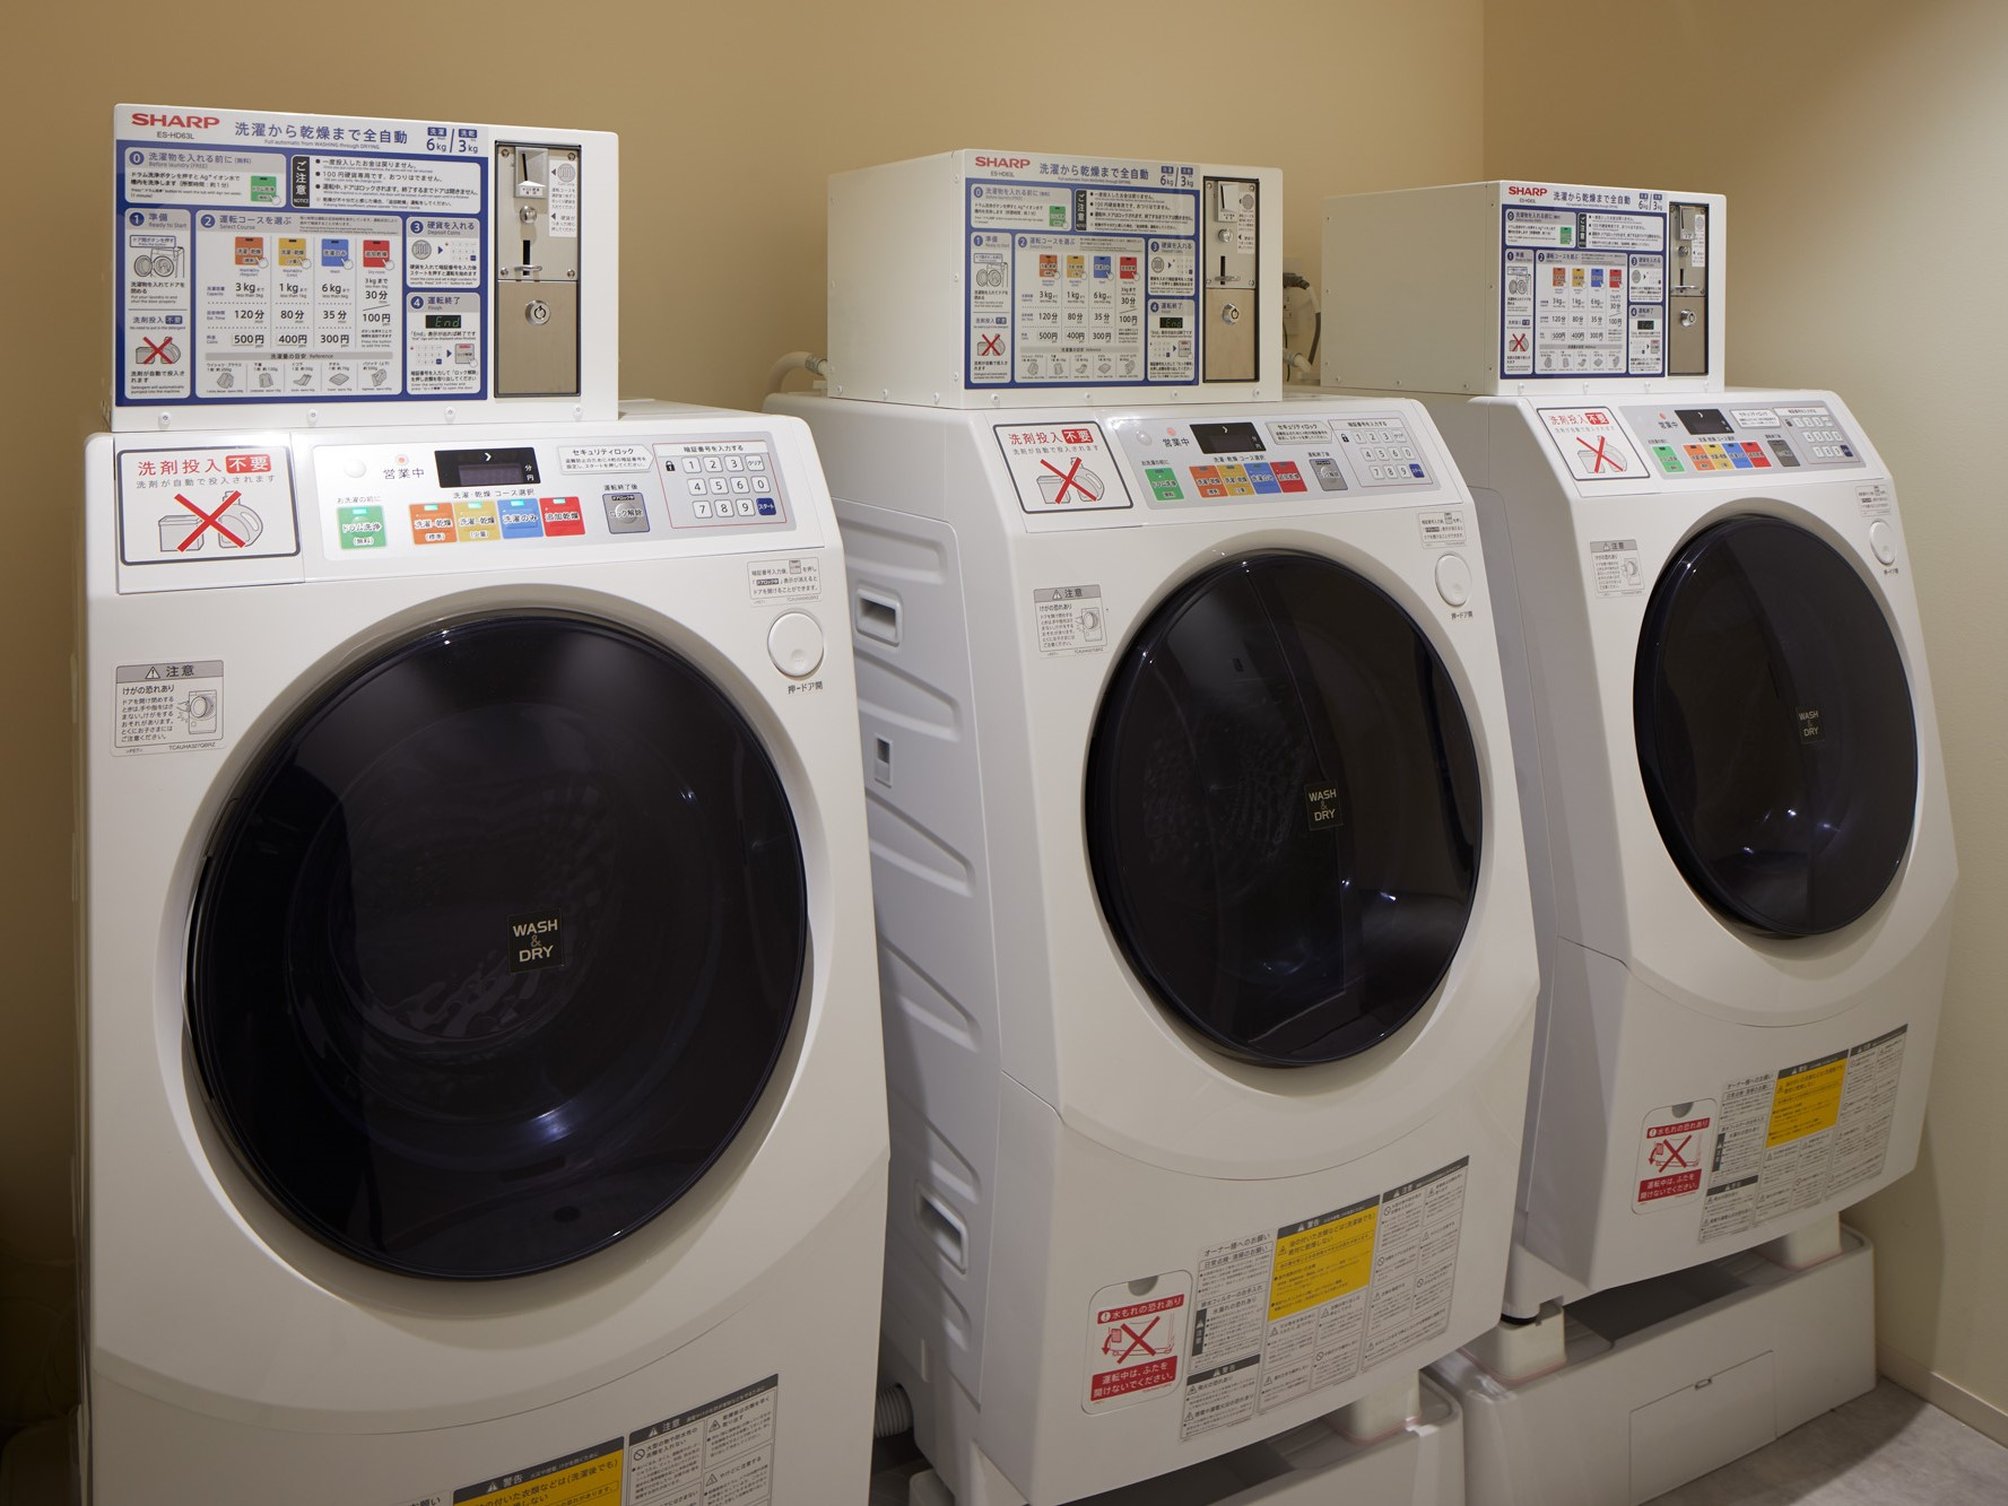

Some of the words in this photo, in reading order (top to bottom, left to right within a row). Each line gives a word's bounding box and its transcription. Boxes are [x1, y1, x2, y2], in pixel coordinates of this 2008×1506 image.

[132, 113, 220, 129] SHARP
[234, 122, 408, 144] 洗濯から乾燥まで全自動
[149, 153, 232, 164] 洗濯物を入れる前に
[975, 156, 1030, 169] SHARP
[1039, 163, 1149, 181] 洗濯から乾燥まで全自動
[297, 161, 307, 195] ご注意
[1508, 186, 1547, 197] SHARP
[1553, 191, 1631, 205] 洗濯から乾燥まで全自動
[149, 213, 167, 221] 準備
[220, 215, 292, 225] 運転コースを選ぶ
[435, 316, 459, 327] End
[1008, 432, 1063, 445] 洗剤投入
[1162, 438, 1190, 448] 営業中
[573, 448, 634, 456] セキュリティロック
[138, 459, 221, 476] 洗剤投入
[228, 456, 269, 472] 不要
[710, 460, 716, 469] 2
[732, 459, 738, 468] 3
[383, 468, 425, 479] 営業中
[136, 475, 274, 489] 洗剤が自動で投入されます
[604, 483, 638, 491] 運転終了後
[694, 482, 701, 491] 4
[716, 481, 722, 491] 5
[737, 480, 744, 489] 6
[757, 480, 764, 489] 0
[496, 488, 534, 497] コース選択
[699, 505, 706, 514] 7
[721, 504, 727, 513] 8
[742, 503, 749, 512] 9
[502, 515, 538, 523] 洗濯のみ
[546, 512, 579, 521] 追加乾燥
[343, 523, 381, 532] ドラム洗浄
[1065, 589, 1082, 598] 注意
[166, 665, 194, 677] 注意
[122, 685, 174, 695] けがの恐れあり
[1799, 710, 1818, 720] WASH
[1804, 726, 1818, 736] DRY
[1308, 789, 1336, 802] WASH
[1314, 809, 1335, 821] DRY
[513, 919, 558, 937] WASH
[531, 935, 541, 947] &
[519, 945, 553, 962] DRY
[1111, 1298, 1182, 1320] 水もれの恐れあり
